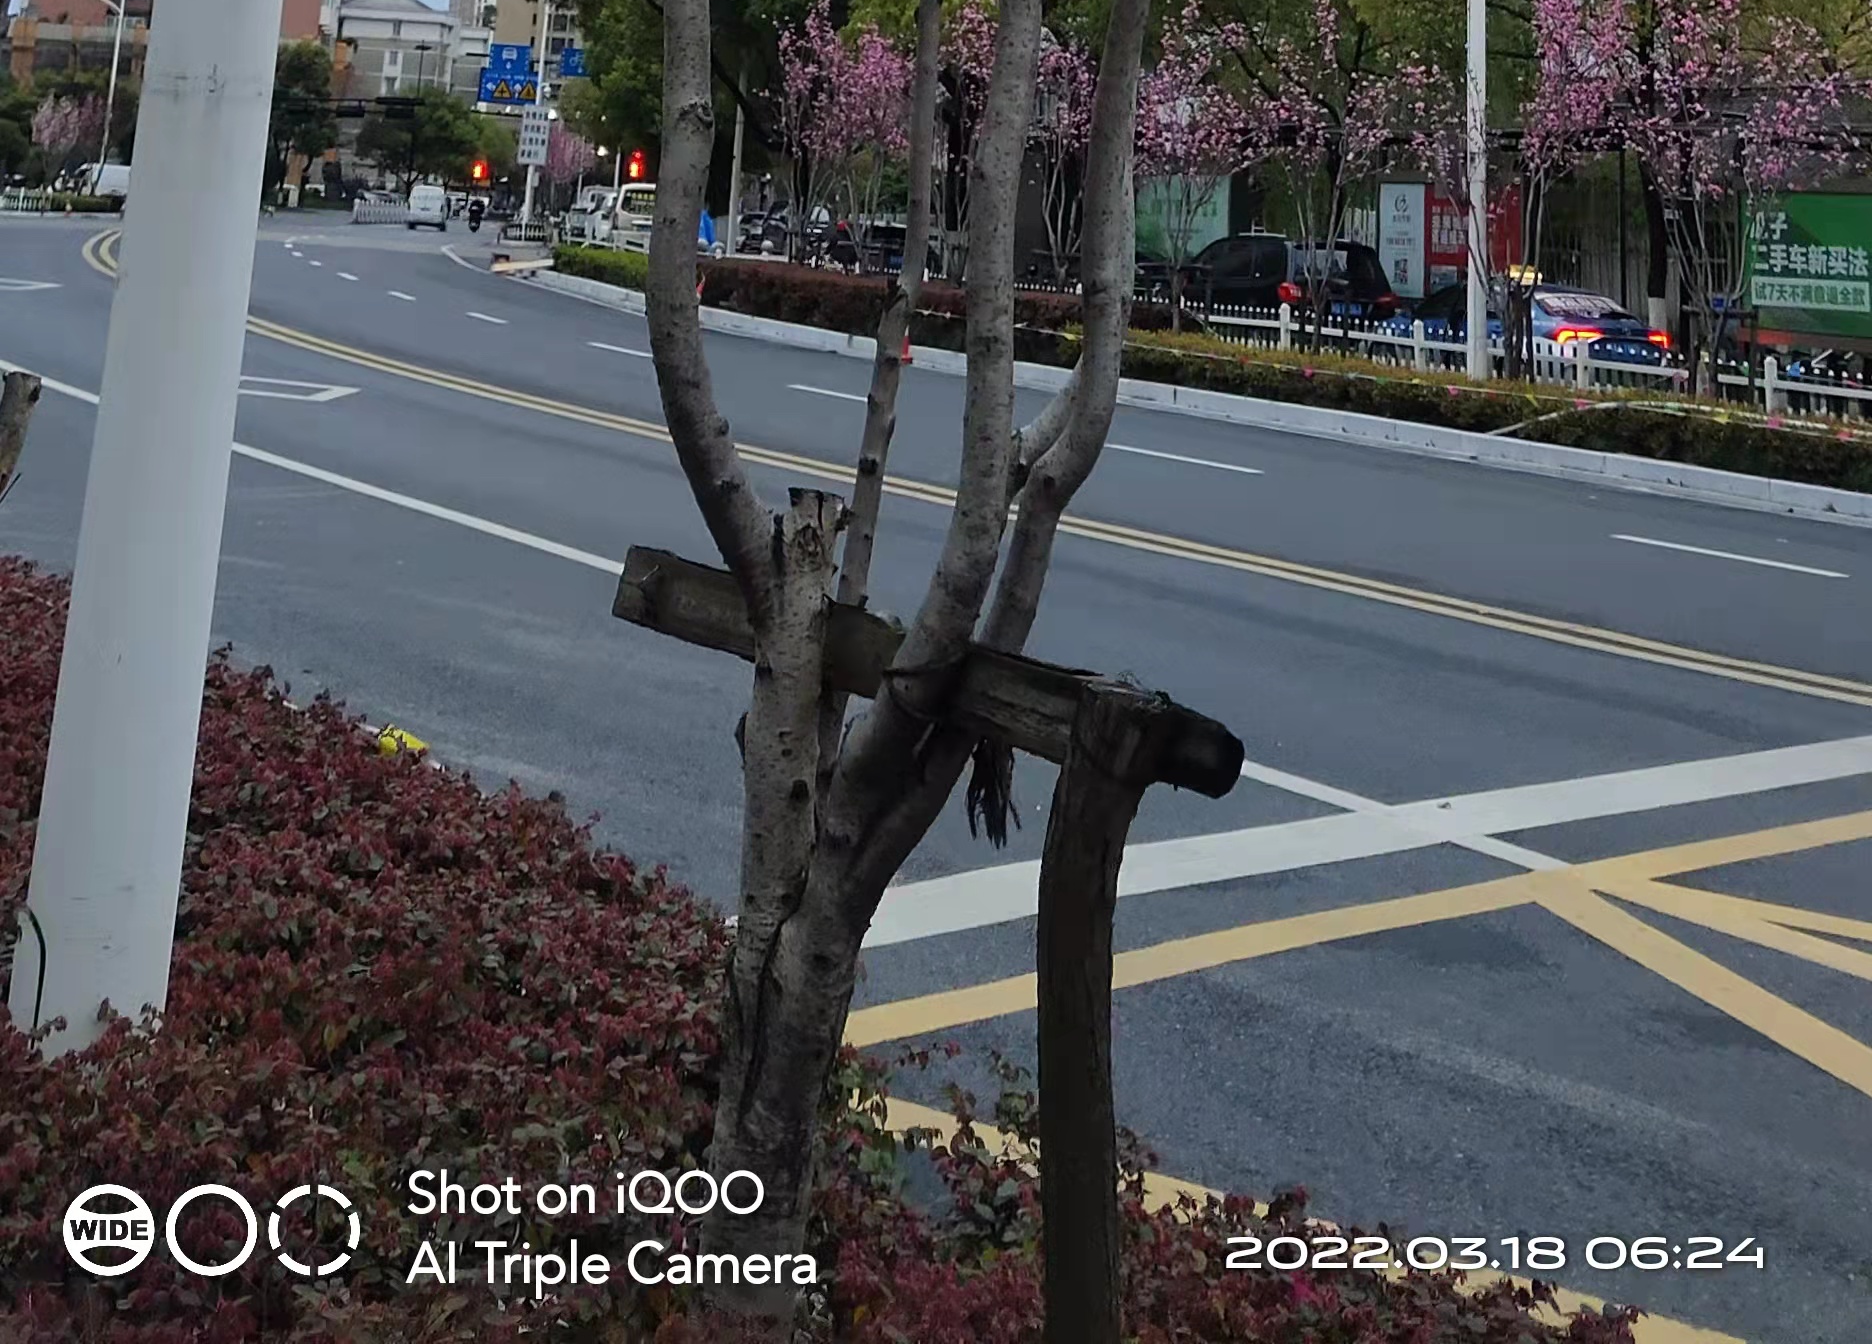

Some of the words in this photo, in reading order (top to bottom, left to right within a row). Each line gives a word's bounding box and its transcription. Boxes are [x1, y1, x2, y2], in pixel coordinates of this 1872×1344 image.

[1752, 243, 1869, 277] 二手车新买法
